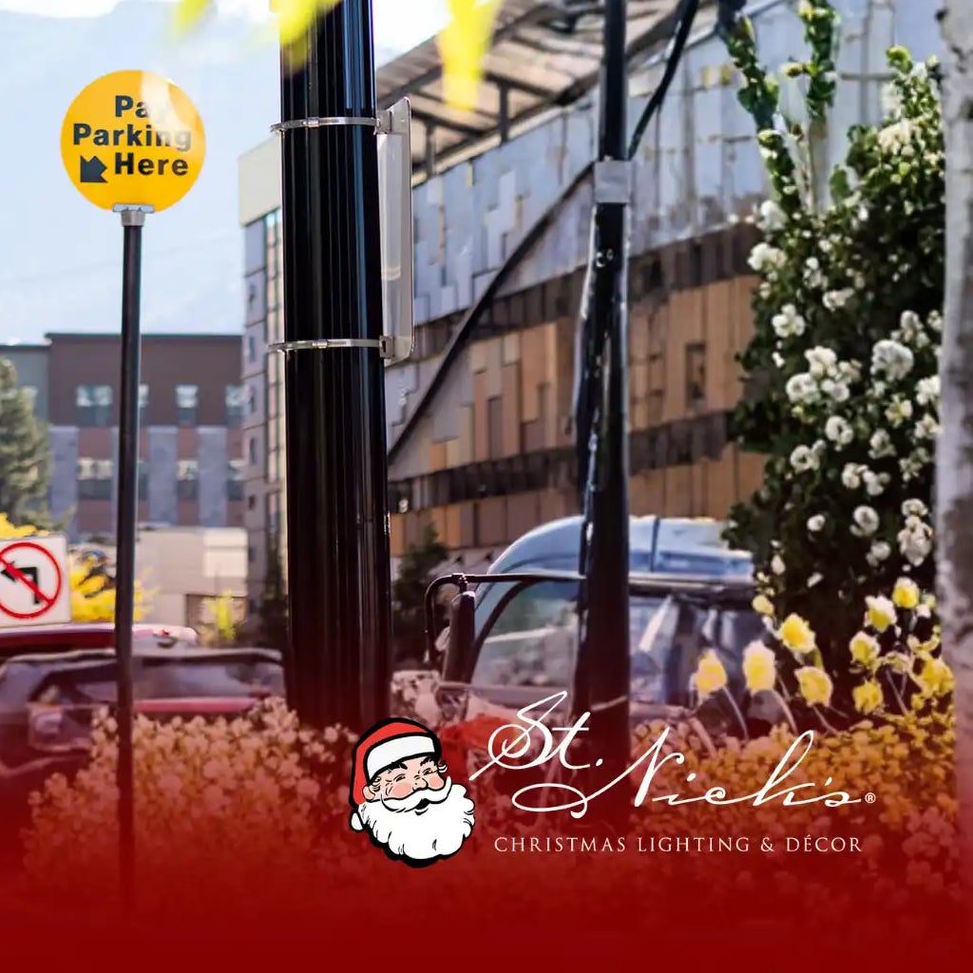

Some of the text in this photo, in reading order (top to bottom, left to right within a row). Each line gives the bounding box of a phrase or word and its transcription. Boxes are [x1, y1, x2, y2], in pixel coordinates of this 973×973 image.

[115, 94, 165, 121] Pa
[73, 123, 191, 152] Parking
[114, 152, 189, 176] Here
